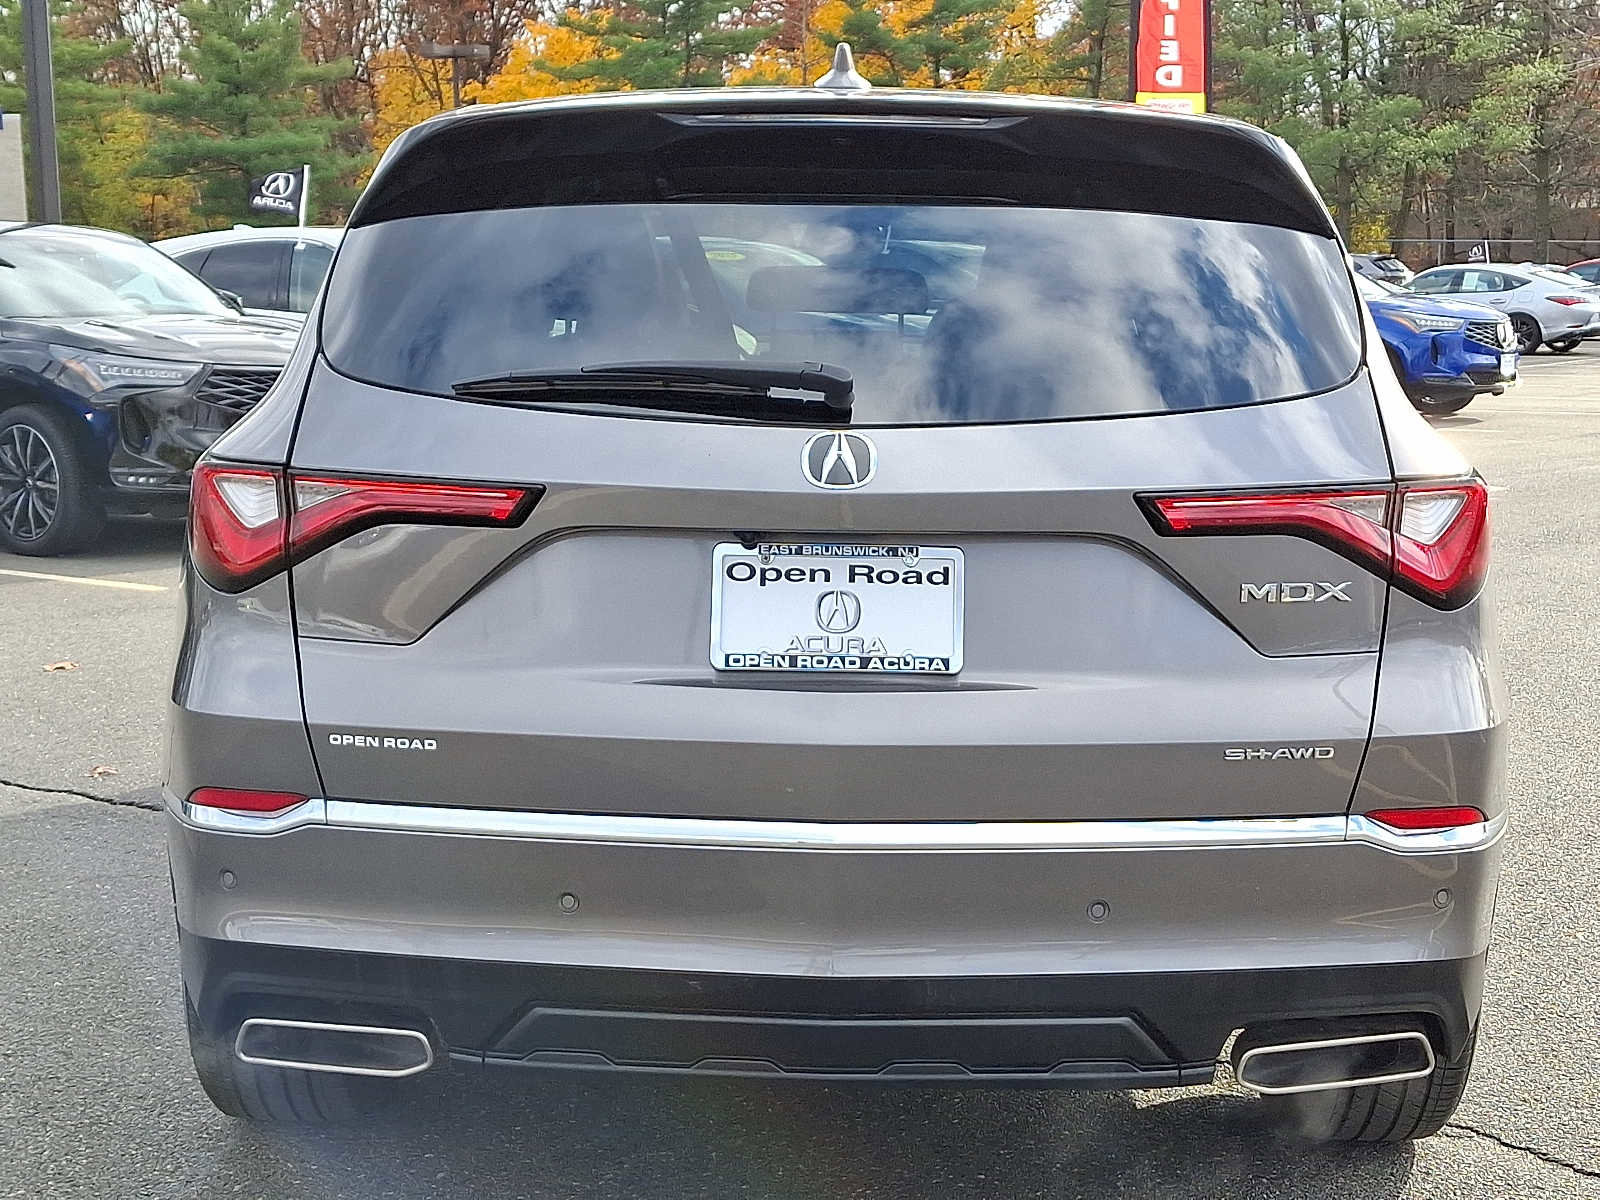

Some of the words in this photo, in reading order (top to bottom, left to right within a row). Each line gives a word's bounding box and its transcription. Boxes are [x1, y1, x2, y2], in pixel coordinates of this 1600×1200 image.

[760, 546, 797, 554] EAST
[898, 547, 918, 557] NJ
[726, 562, 830, 586] Open
[848, 565, 949, 585] Road
[1240, 582, 1352, 603] MDX
[784, 635, 888, 655] ACURA
[728, 654, 789, 668] OPEN
[797, 655, 860, 669] ROAD
[868, 656, 945, 670] ACURA
[329, 734, 379, 748] OPEN
[384, 738, 437, 750] ROAD
[1224, 747, 1335, 760] SH-AWD
